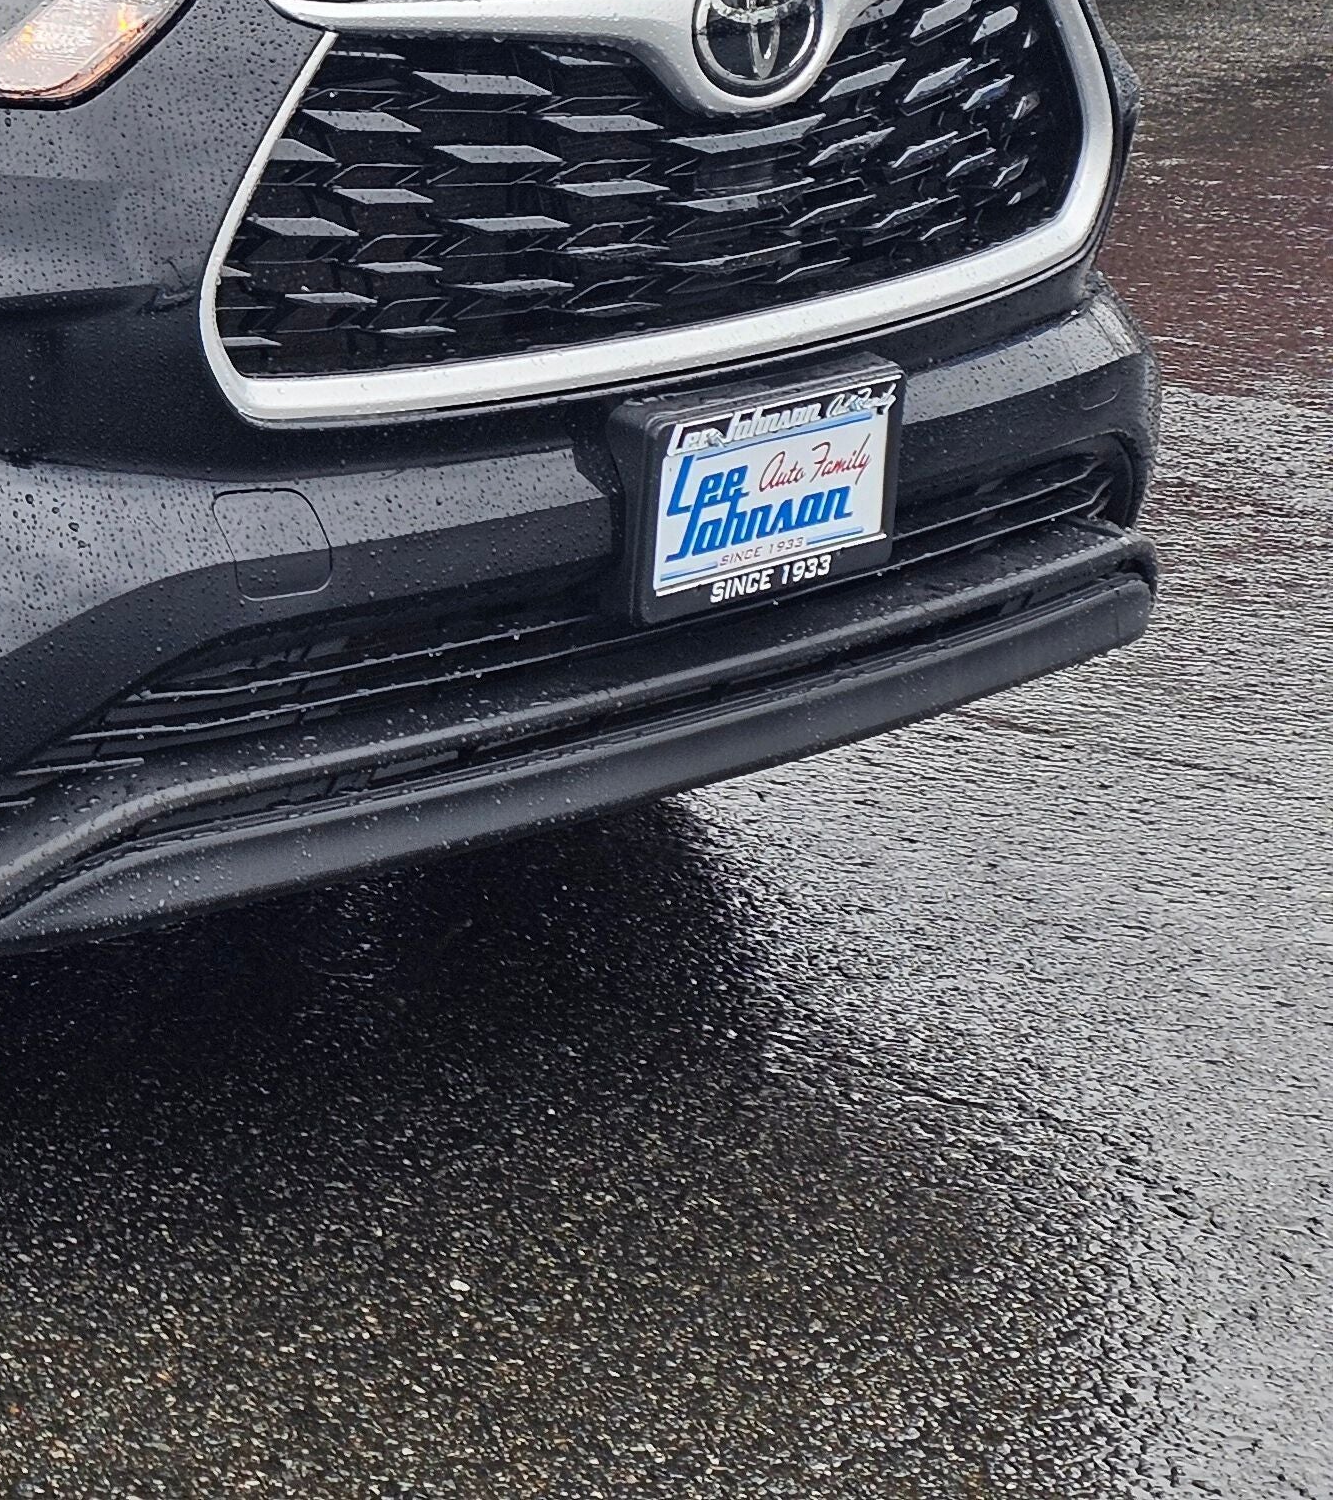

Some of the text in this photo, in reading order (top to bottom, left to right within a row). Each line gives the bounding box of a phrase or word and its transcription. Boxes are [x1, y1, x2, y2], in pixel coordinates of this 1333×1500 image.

[667, 423, 723, 456] Lee
[721, 402, 823, 445] Johnson
[666, 454, 751, 517] Lee
[758, 433, 872, 492] Auto Family
[664, 485, 854, 564] Johnson
[719, 537, 806, 567] SINCE 1933
[709, 555, 832, 604] SINCE 1933
